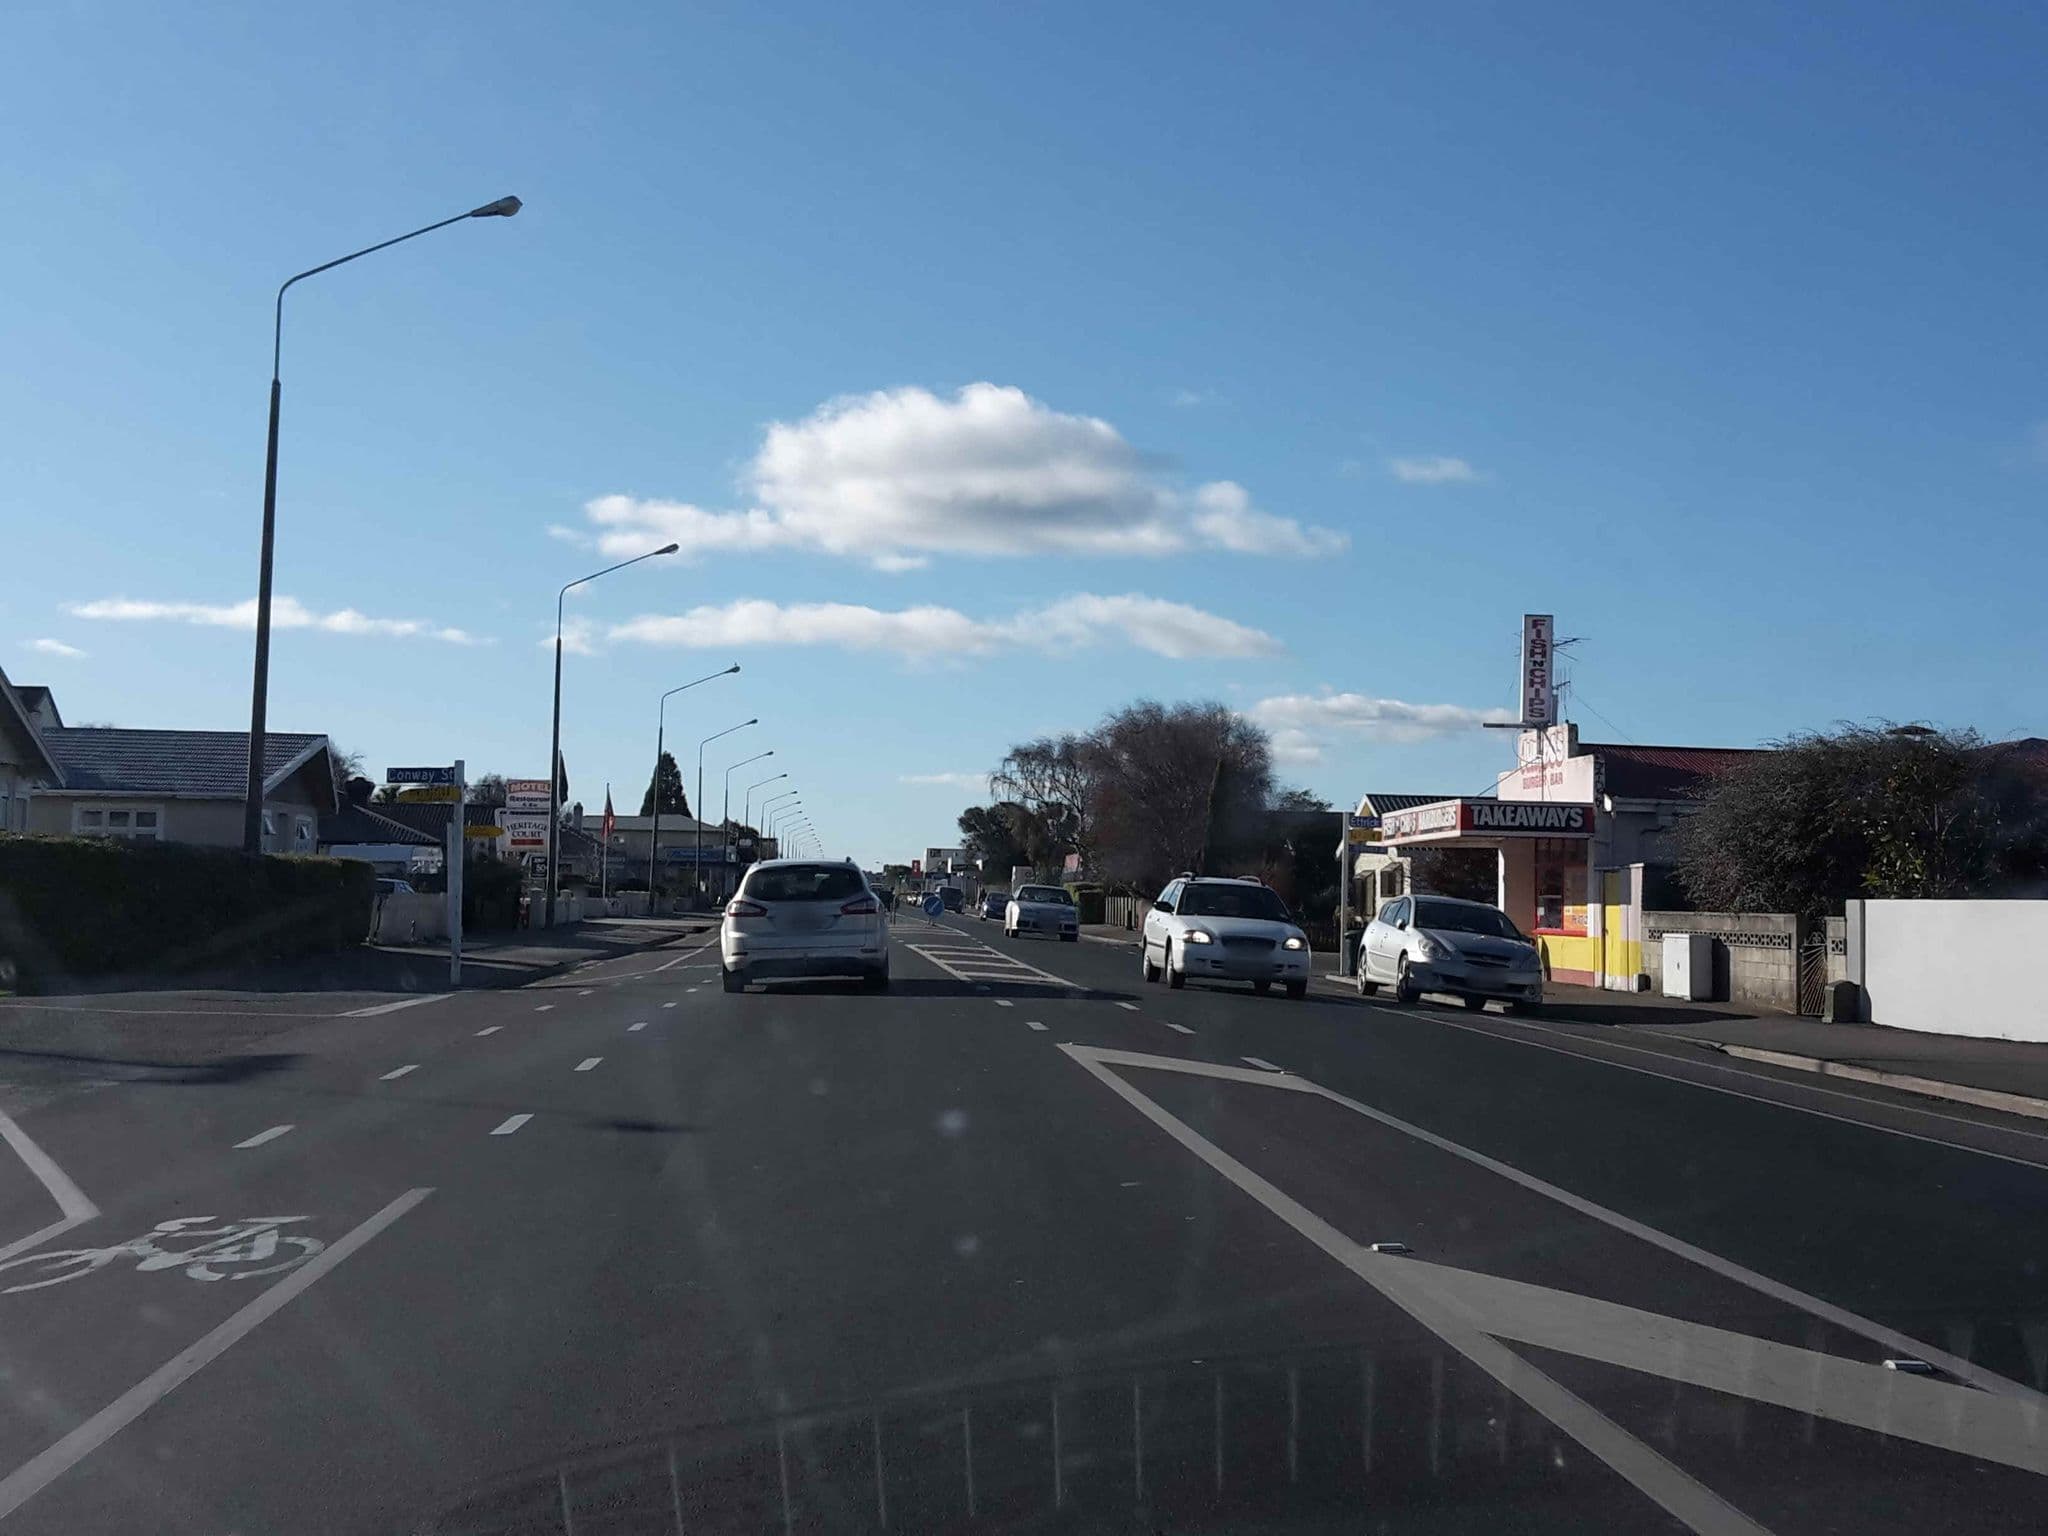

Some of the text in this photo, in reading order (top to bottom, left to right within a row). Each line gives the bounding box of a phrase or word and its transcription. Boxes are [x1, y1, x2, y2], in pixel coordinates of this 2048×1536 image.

[1529, 618, 1547, 660] FISH
[1528, 667, 1546, 718] CHIPS
[388, 769, 454, 783] Conway St
[508, 783, 551, 793] MOTEL
[1471, 805, 1584, 828] TAKEAWAYS
[506, 822, 547, 832] HERITAGE
[511, 830, 543, 838] COURT
